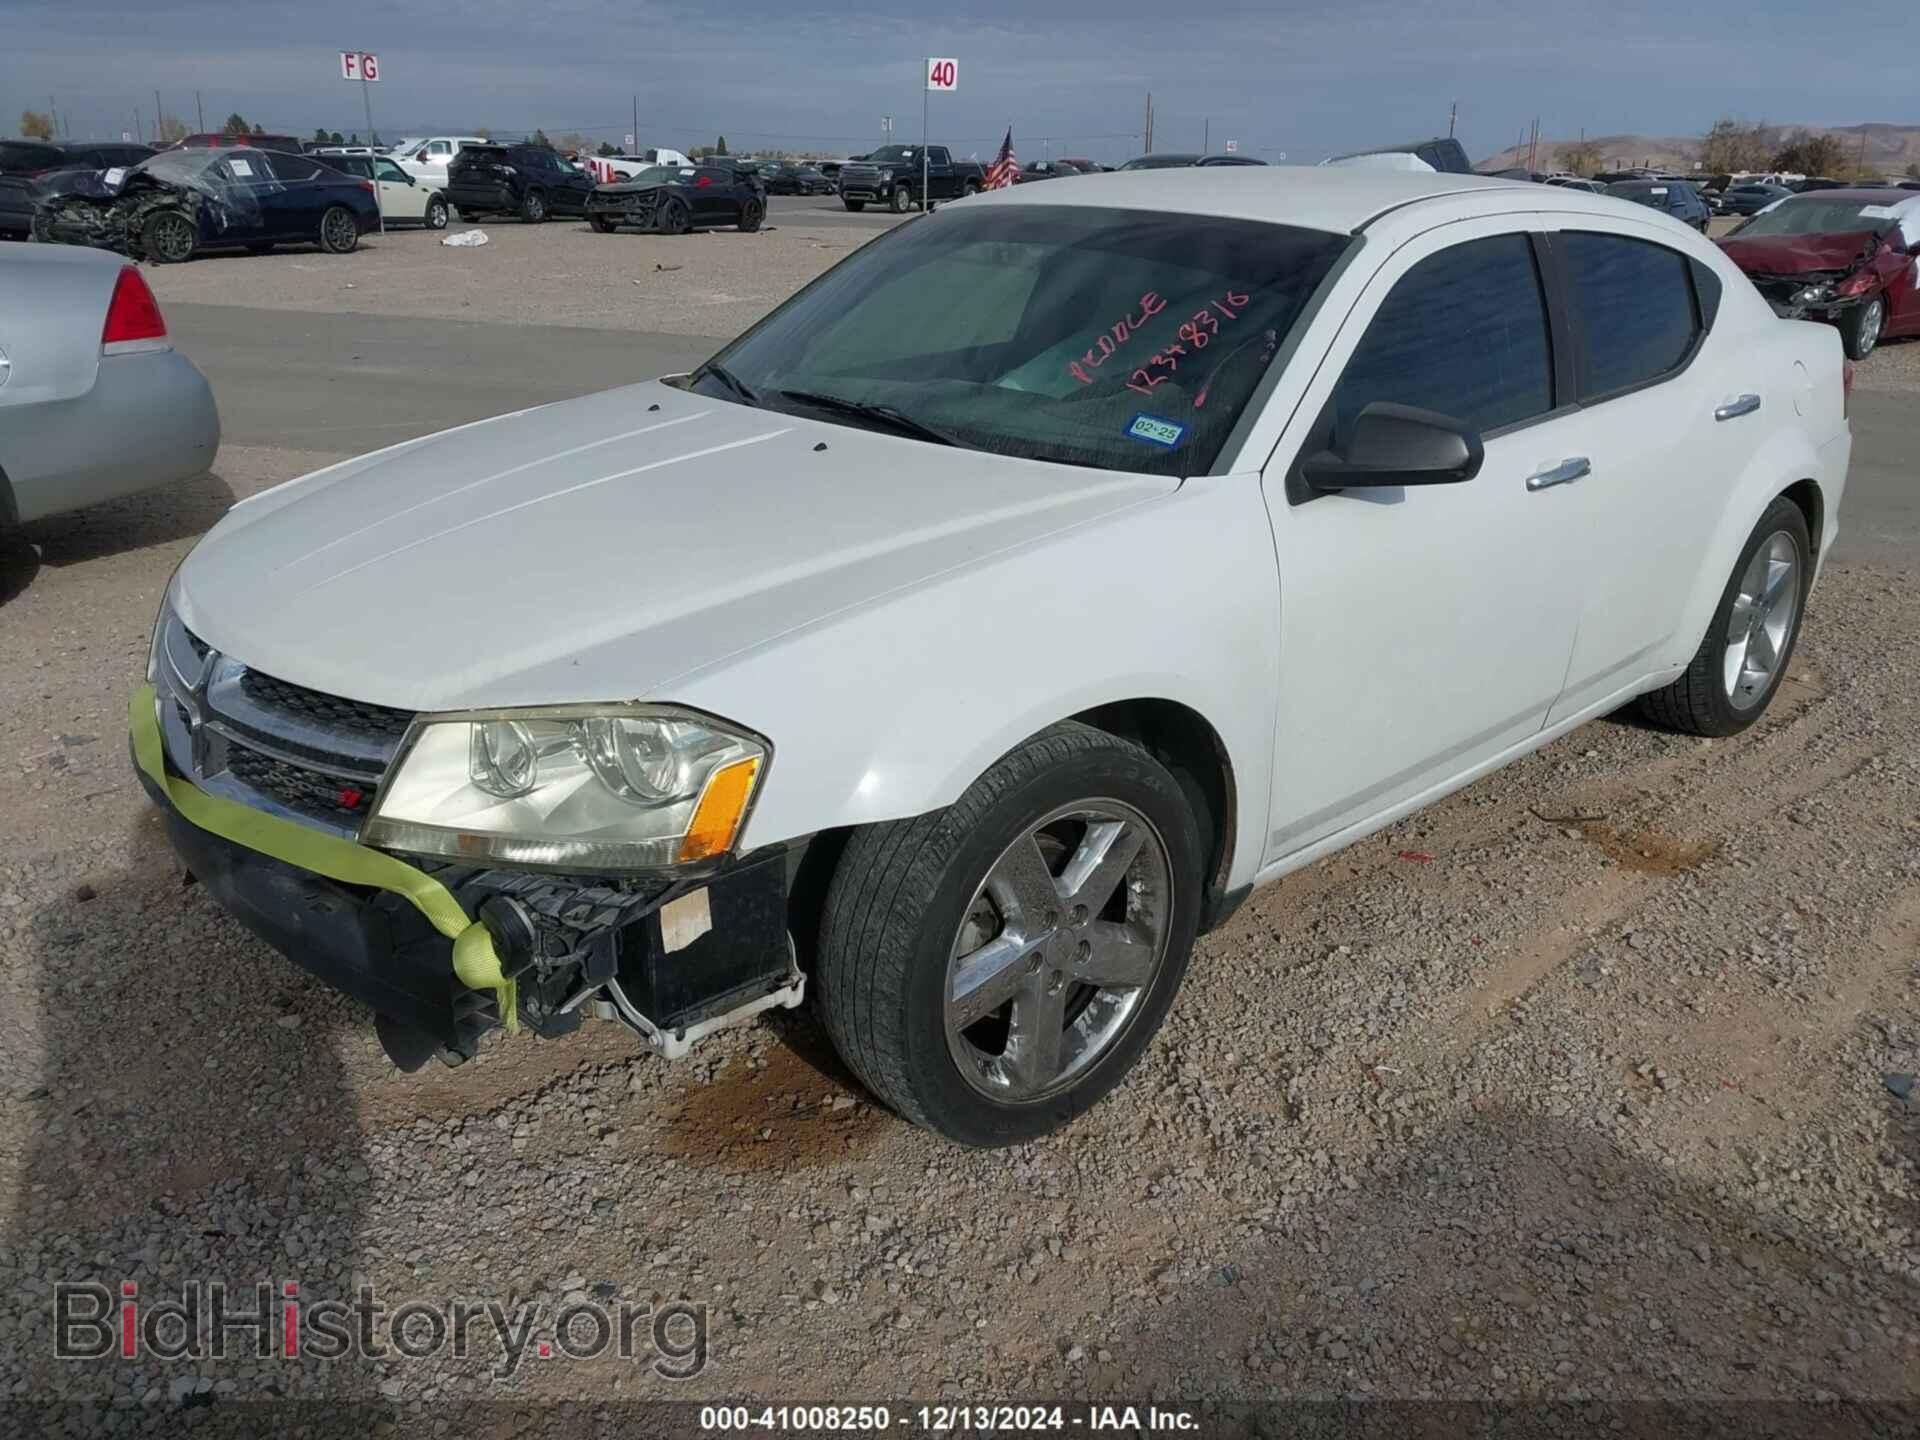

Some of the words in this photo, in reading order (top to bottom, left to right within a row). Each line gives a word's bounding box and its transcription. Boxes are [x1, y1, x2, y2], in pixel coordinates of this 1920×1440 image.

[345, 53, 355, 77] F
[363, 55, 376, 80] G
[930, 61, 954, 87] 40
